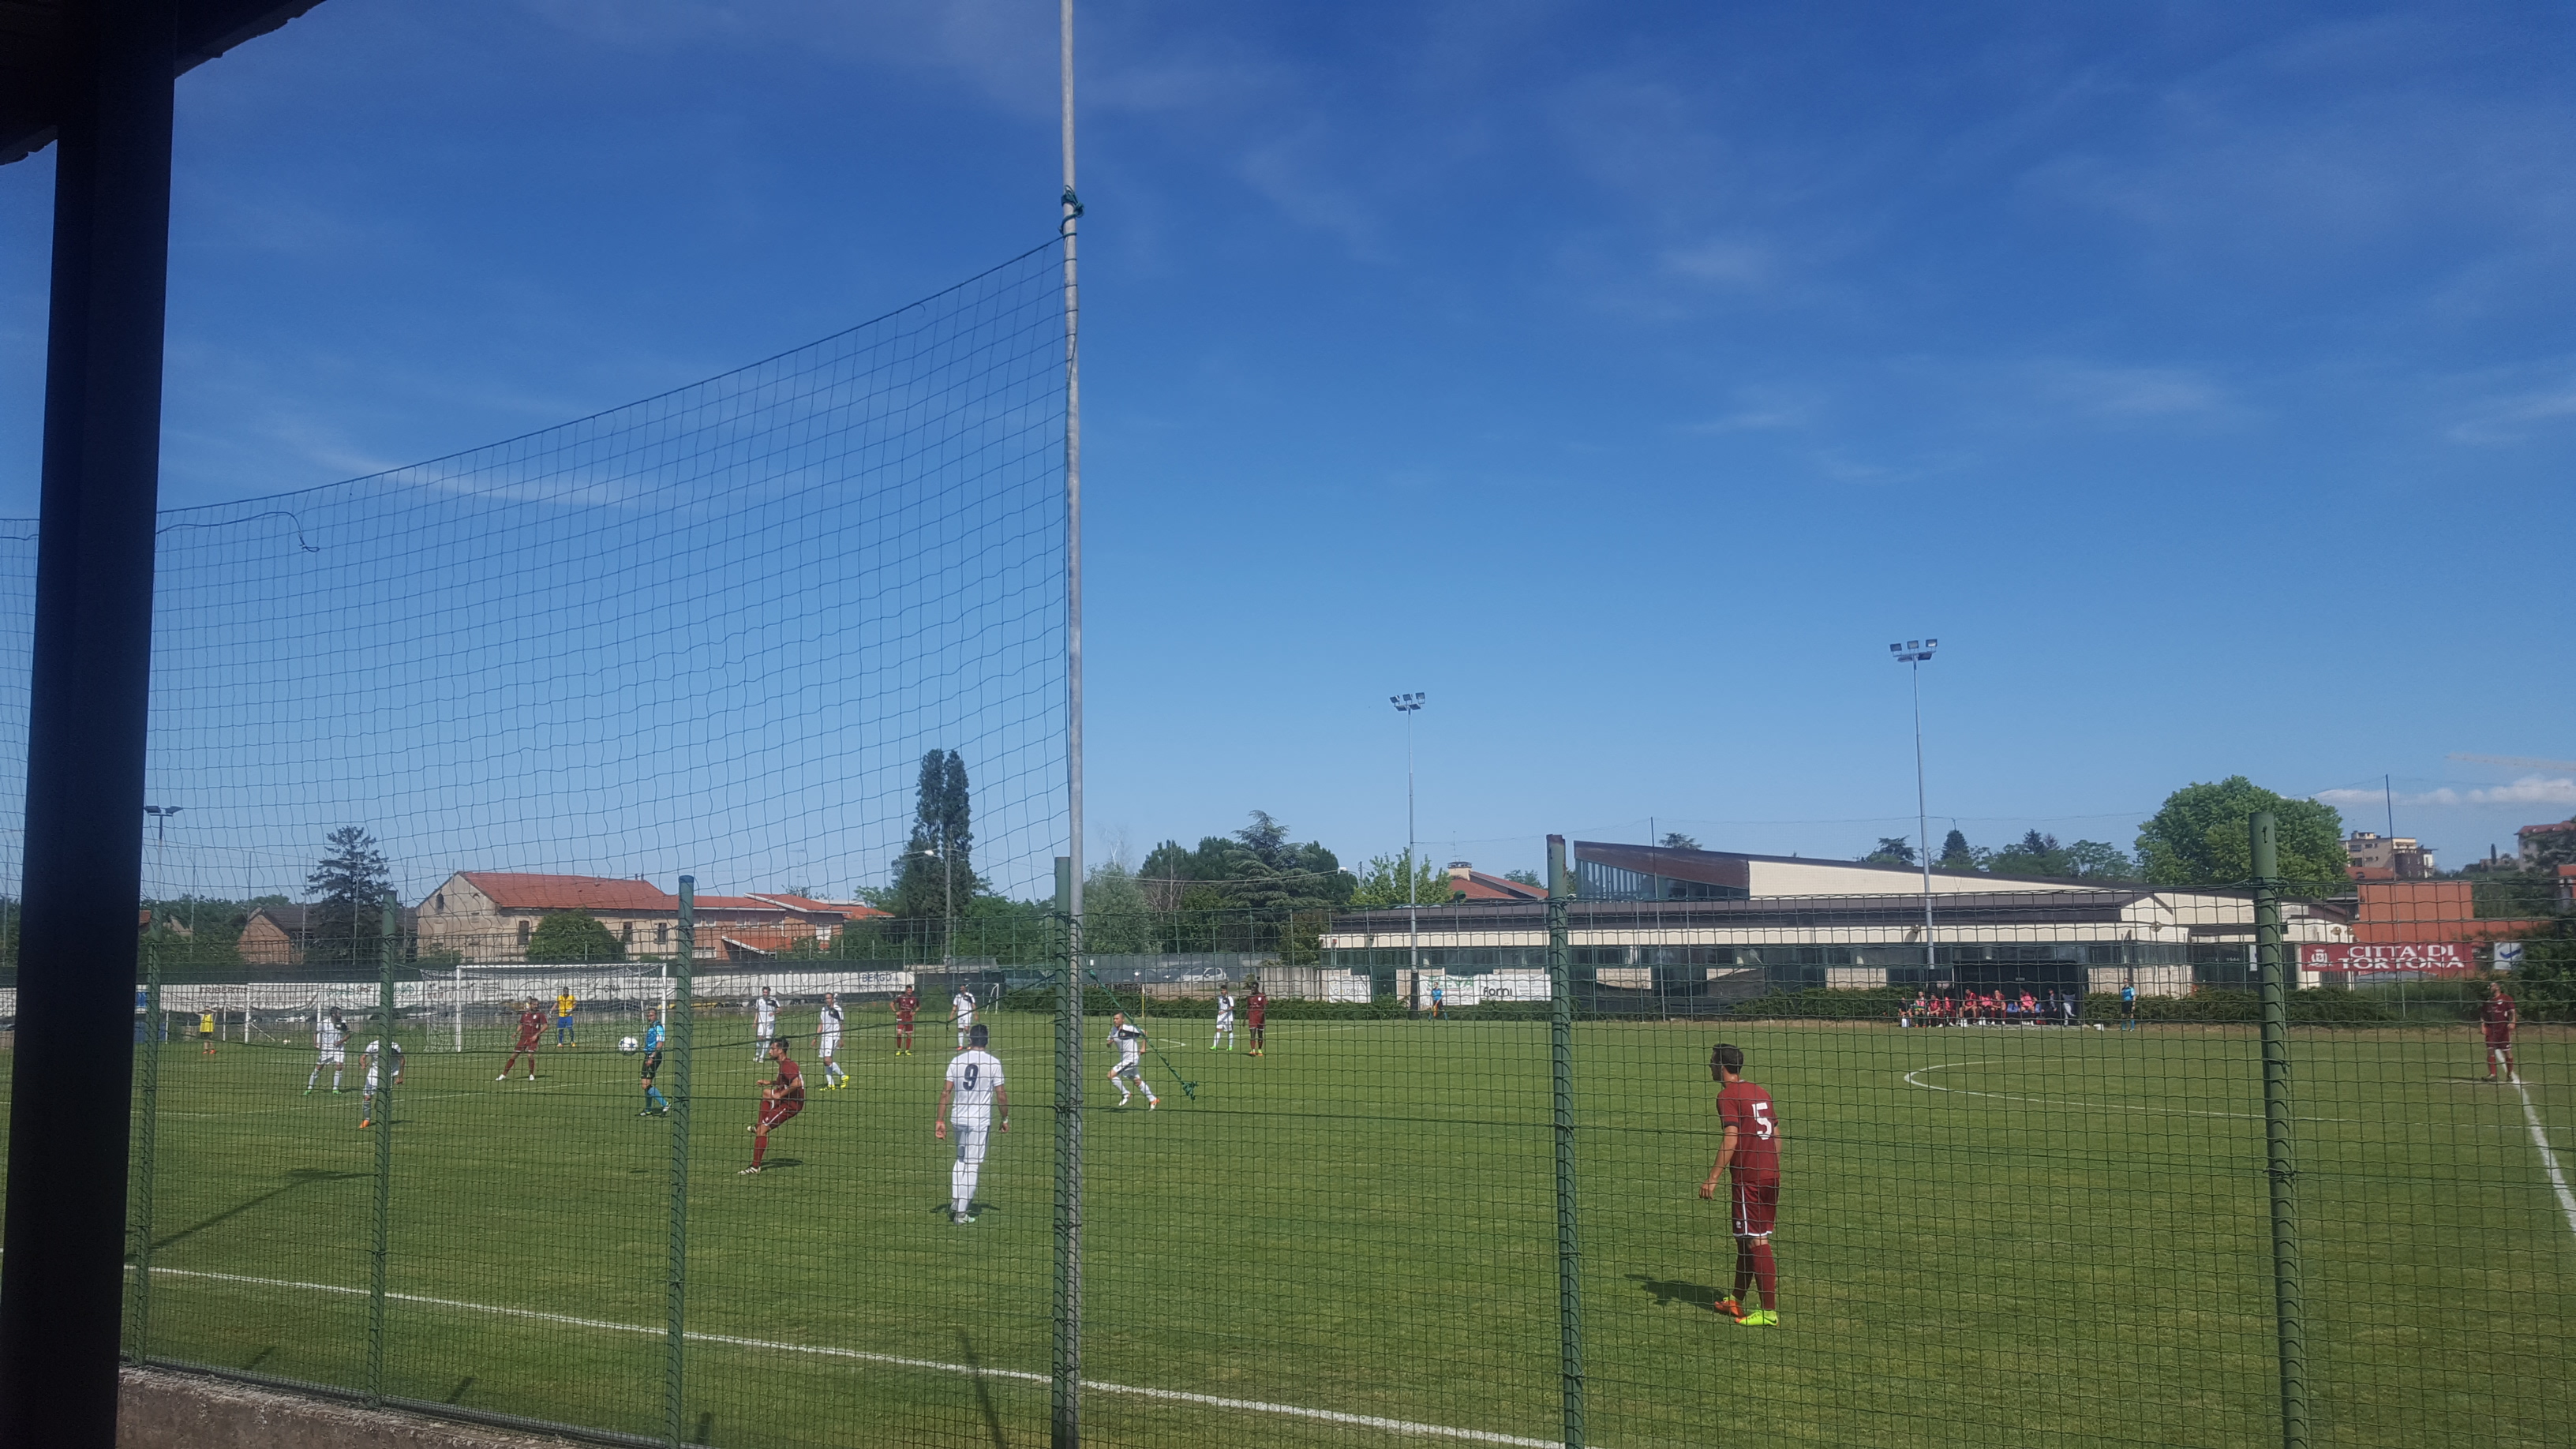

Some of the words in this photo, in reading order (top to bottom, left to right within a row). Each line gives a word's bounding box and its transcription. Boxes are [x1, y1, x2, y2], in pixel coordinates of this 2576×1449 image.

[2428, 945, 2454, 957] DI
[2338, 957, 2465, 969] TORTONA
[862, 973, 892, 983] BERGO
[962, 1063, 979, 1091] 9
[1751, 1103, 1773, 1140] 5
